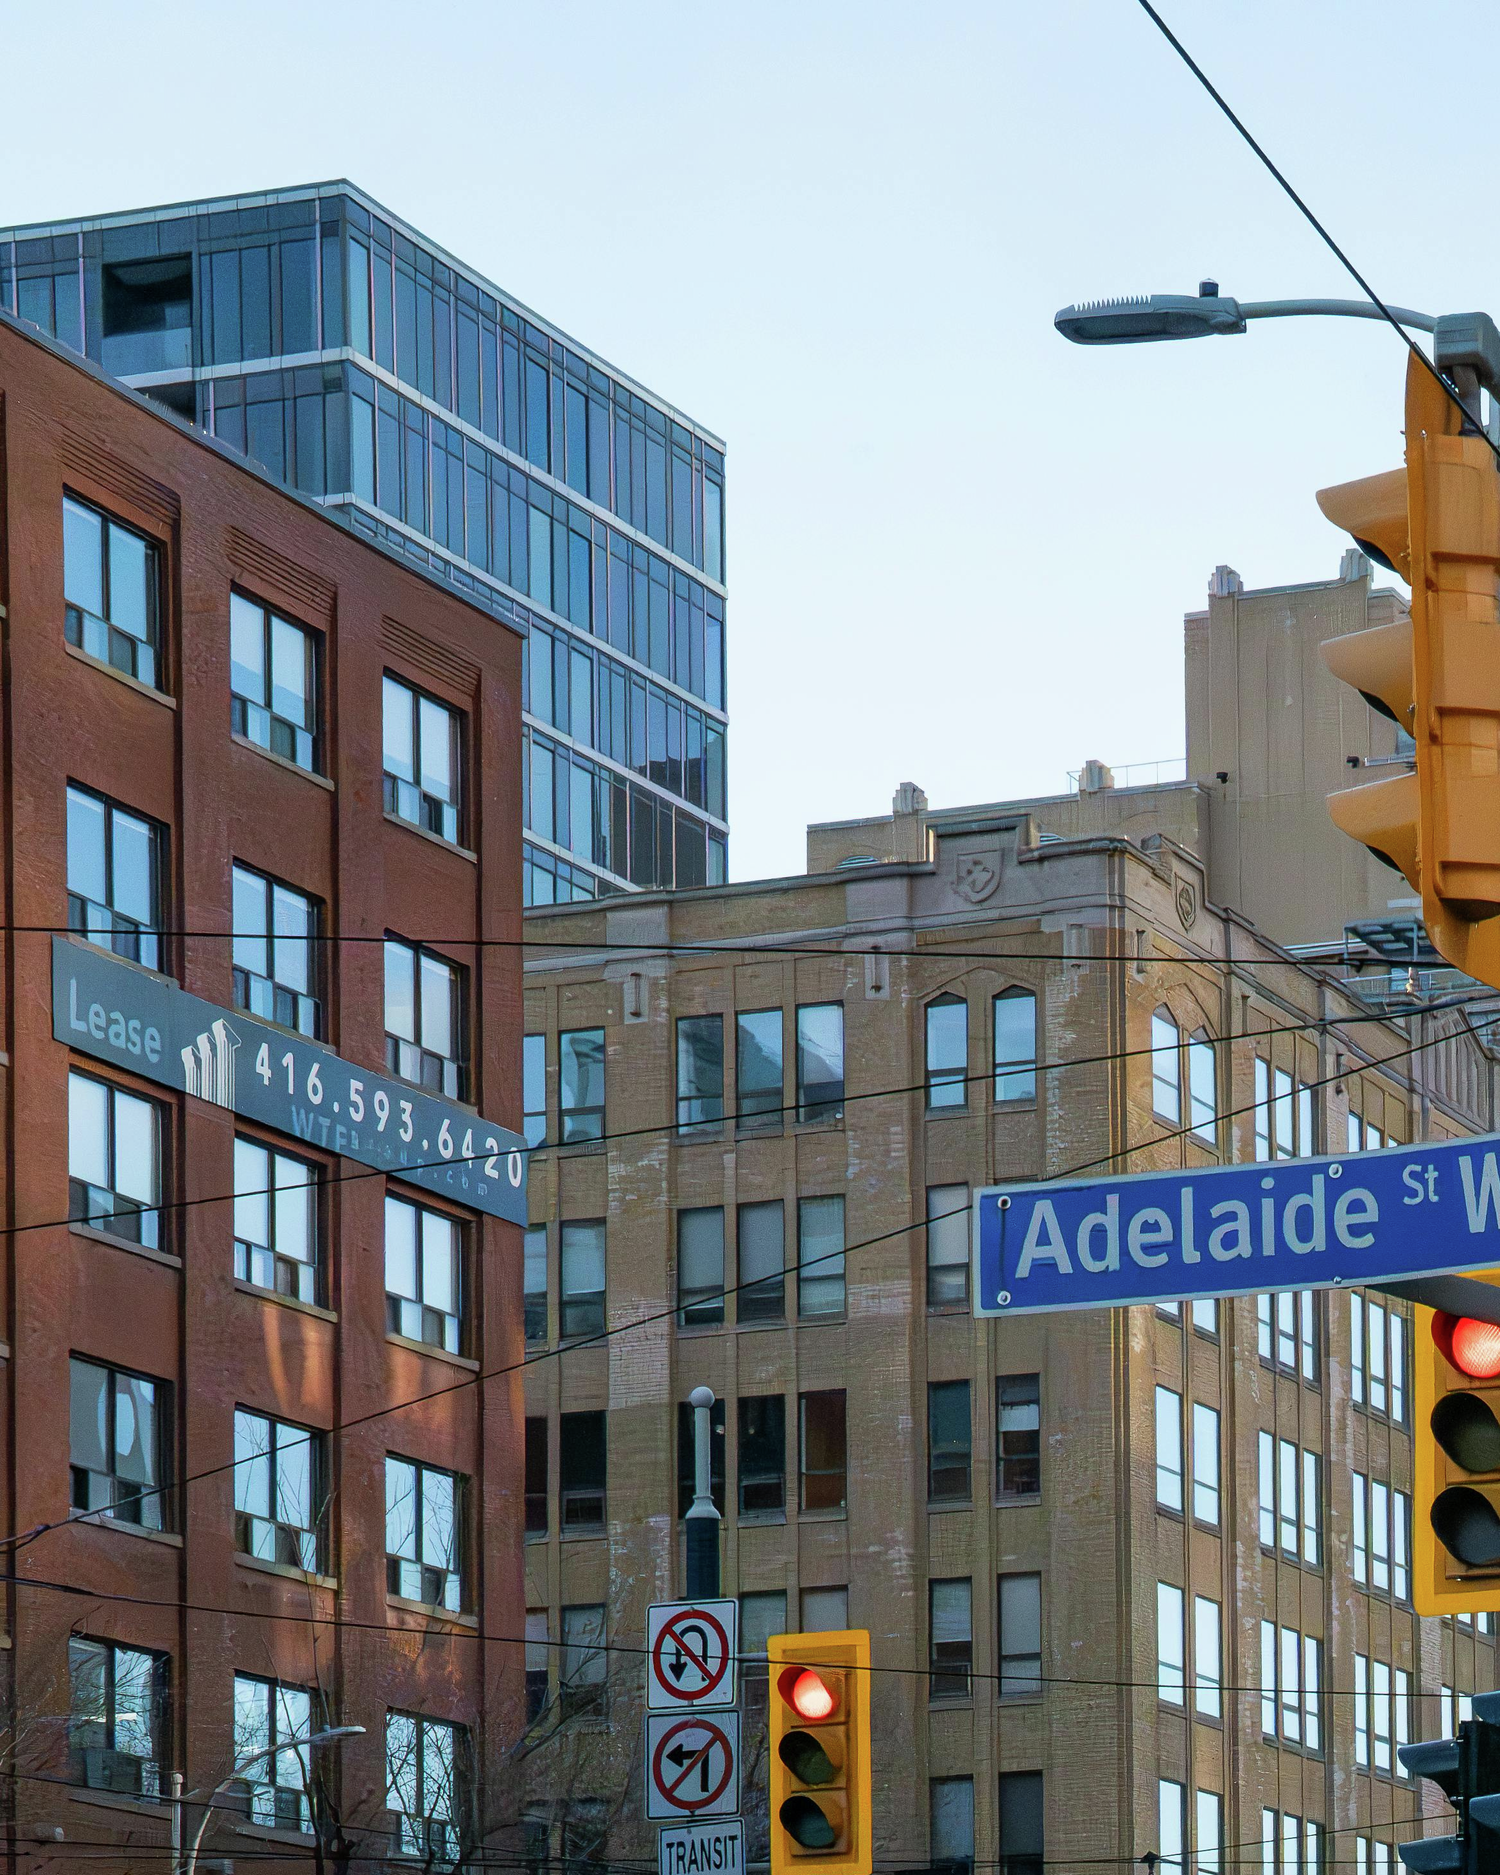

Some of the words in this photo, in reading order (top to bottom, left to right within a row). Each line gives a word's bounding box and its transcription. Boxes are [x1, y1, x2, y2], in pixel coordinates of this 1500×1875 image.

[70, 976, 162, 1063] Lease
[256, 1042, 523, 1188] 416.593.6420
[1015, 1173, 1380, 1279] Adelaide
[1402, 1164, 1440, 1206] St
[666, 1834, 739, 1875] TRANSIT
